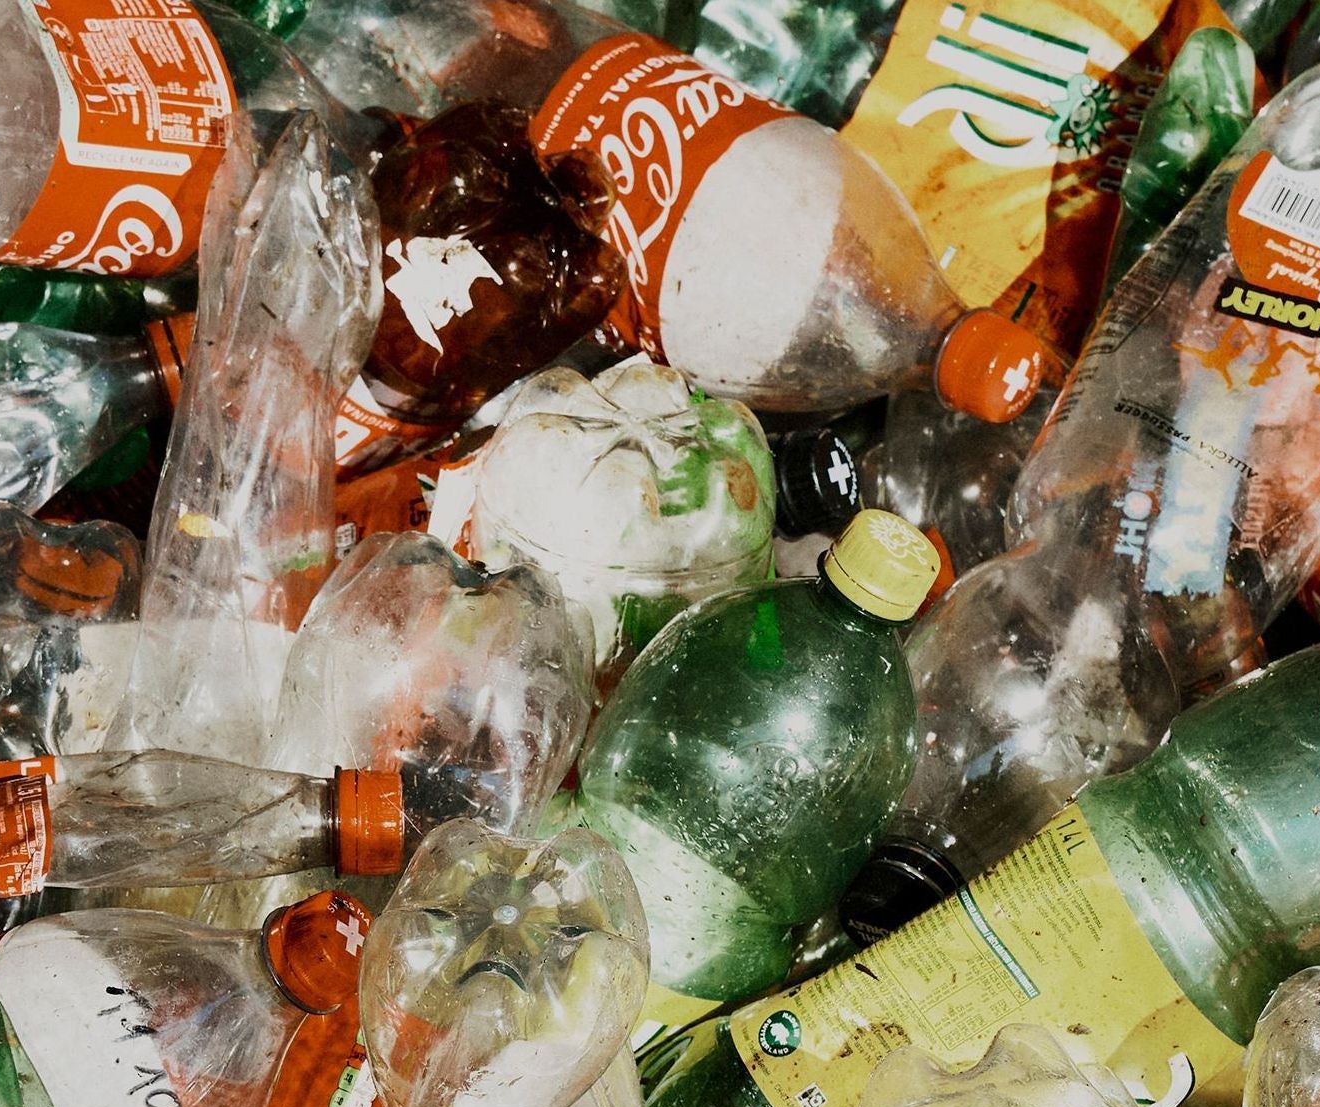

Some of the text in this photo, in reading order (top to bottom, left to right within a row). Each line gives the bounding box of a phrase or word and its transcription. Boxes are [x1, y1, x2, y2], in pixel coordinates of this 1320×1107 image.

[534, 76, 584, 154] Refreshing
[1112, 397, 1261, 482] ALLEGRA PASSUGGER
[1055, 817, 1087, 855] 1.4 L
